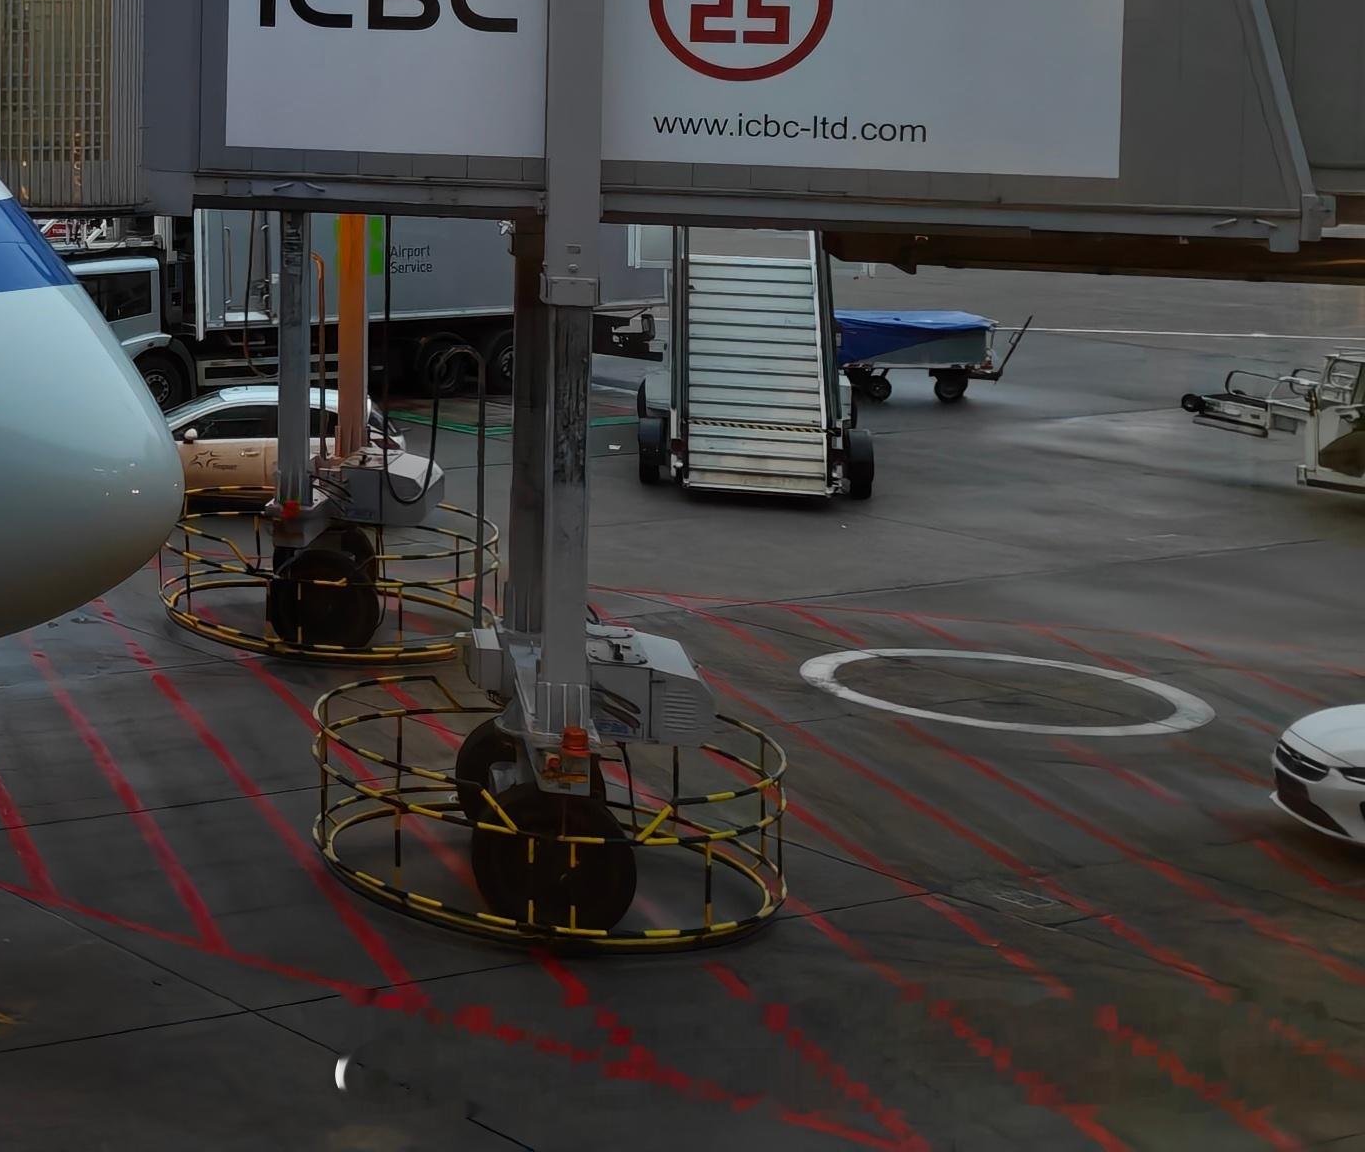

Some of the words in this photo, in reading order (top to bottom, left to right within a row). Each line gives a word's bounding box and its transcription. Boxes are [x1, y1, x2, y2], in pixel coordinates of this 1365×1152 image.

[653, 112, 927, 143] www.icbc-ltd.com
[390, 245, 431, 260] Airport
[390, 260, 433, 274] Service
